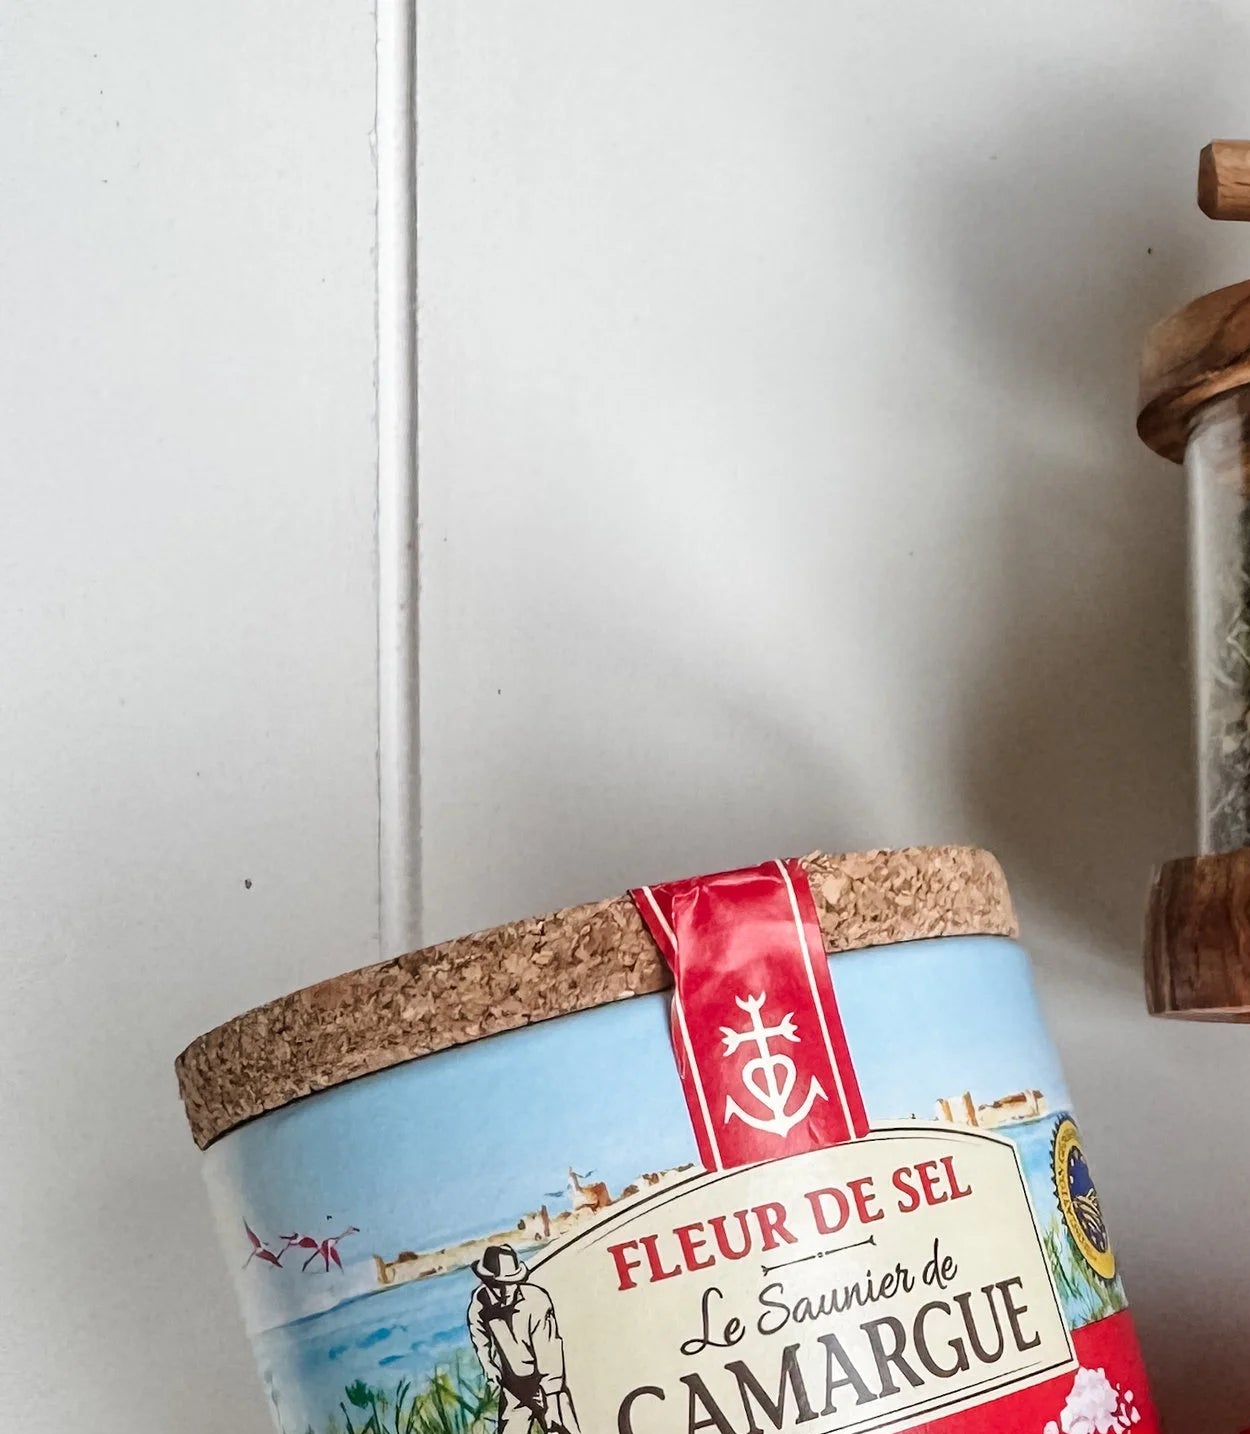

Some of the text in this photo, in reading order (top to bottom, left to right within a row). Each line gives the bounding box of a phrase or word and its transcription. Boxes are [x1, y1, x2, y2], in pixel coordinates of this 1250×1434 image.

[608, 1155, 973, 1291] FLEUR DE SEL
[680, 1238, 958, 1357] Le Saunier de
